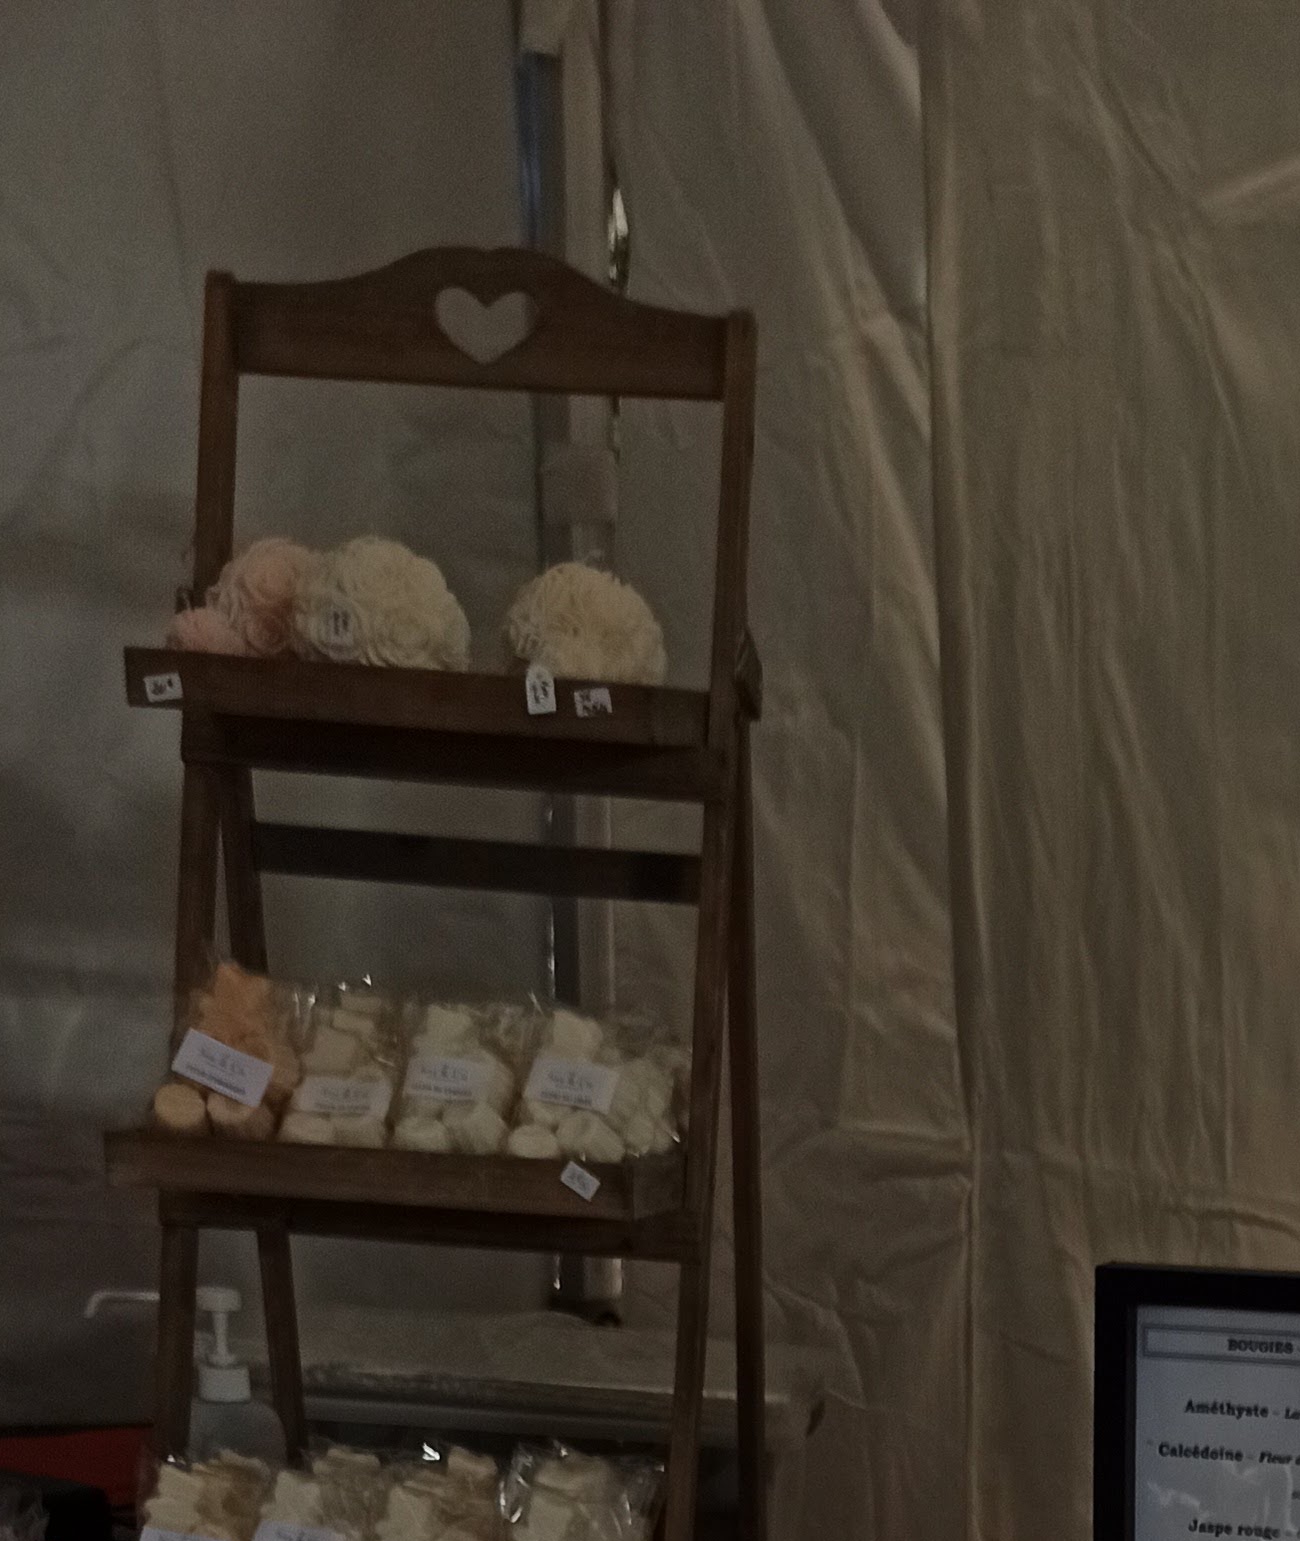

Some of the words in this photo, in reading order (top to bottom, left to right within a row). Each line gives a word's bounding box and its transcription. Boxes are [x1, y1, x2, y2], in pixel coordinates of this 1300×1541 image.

[1184, 1400, 1269, 1420] Améthyste
[1188, 1518, 1232, 1537] Jaspe
[1237, 1524, 1280, 1540] rouge
